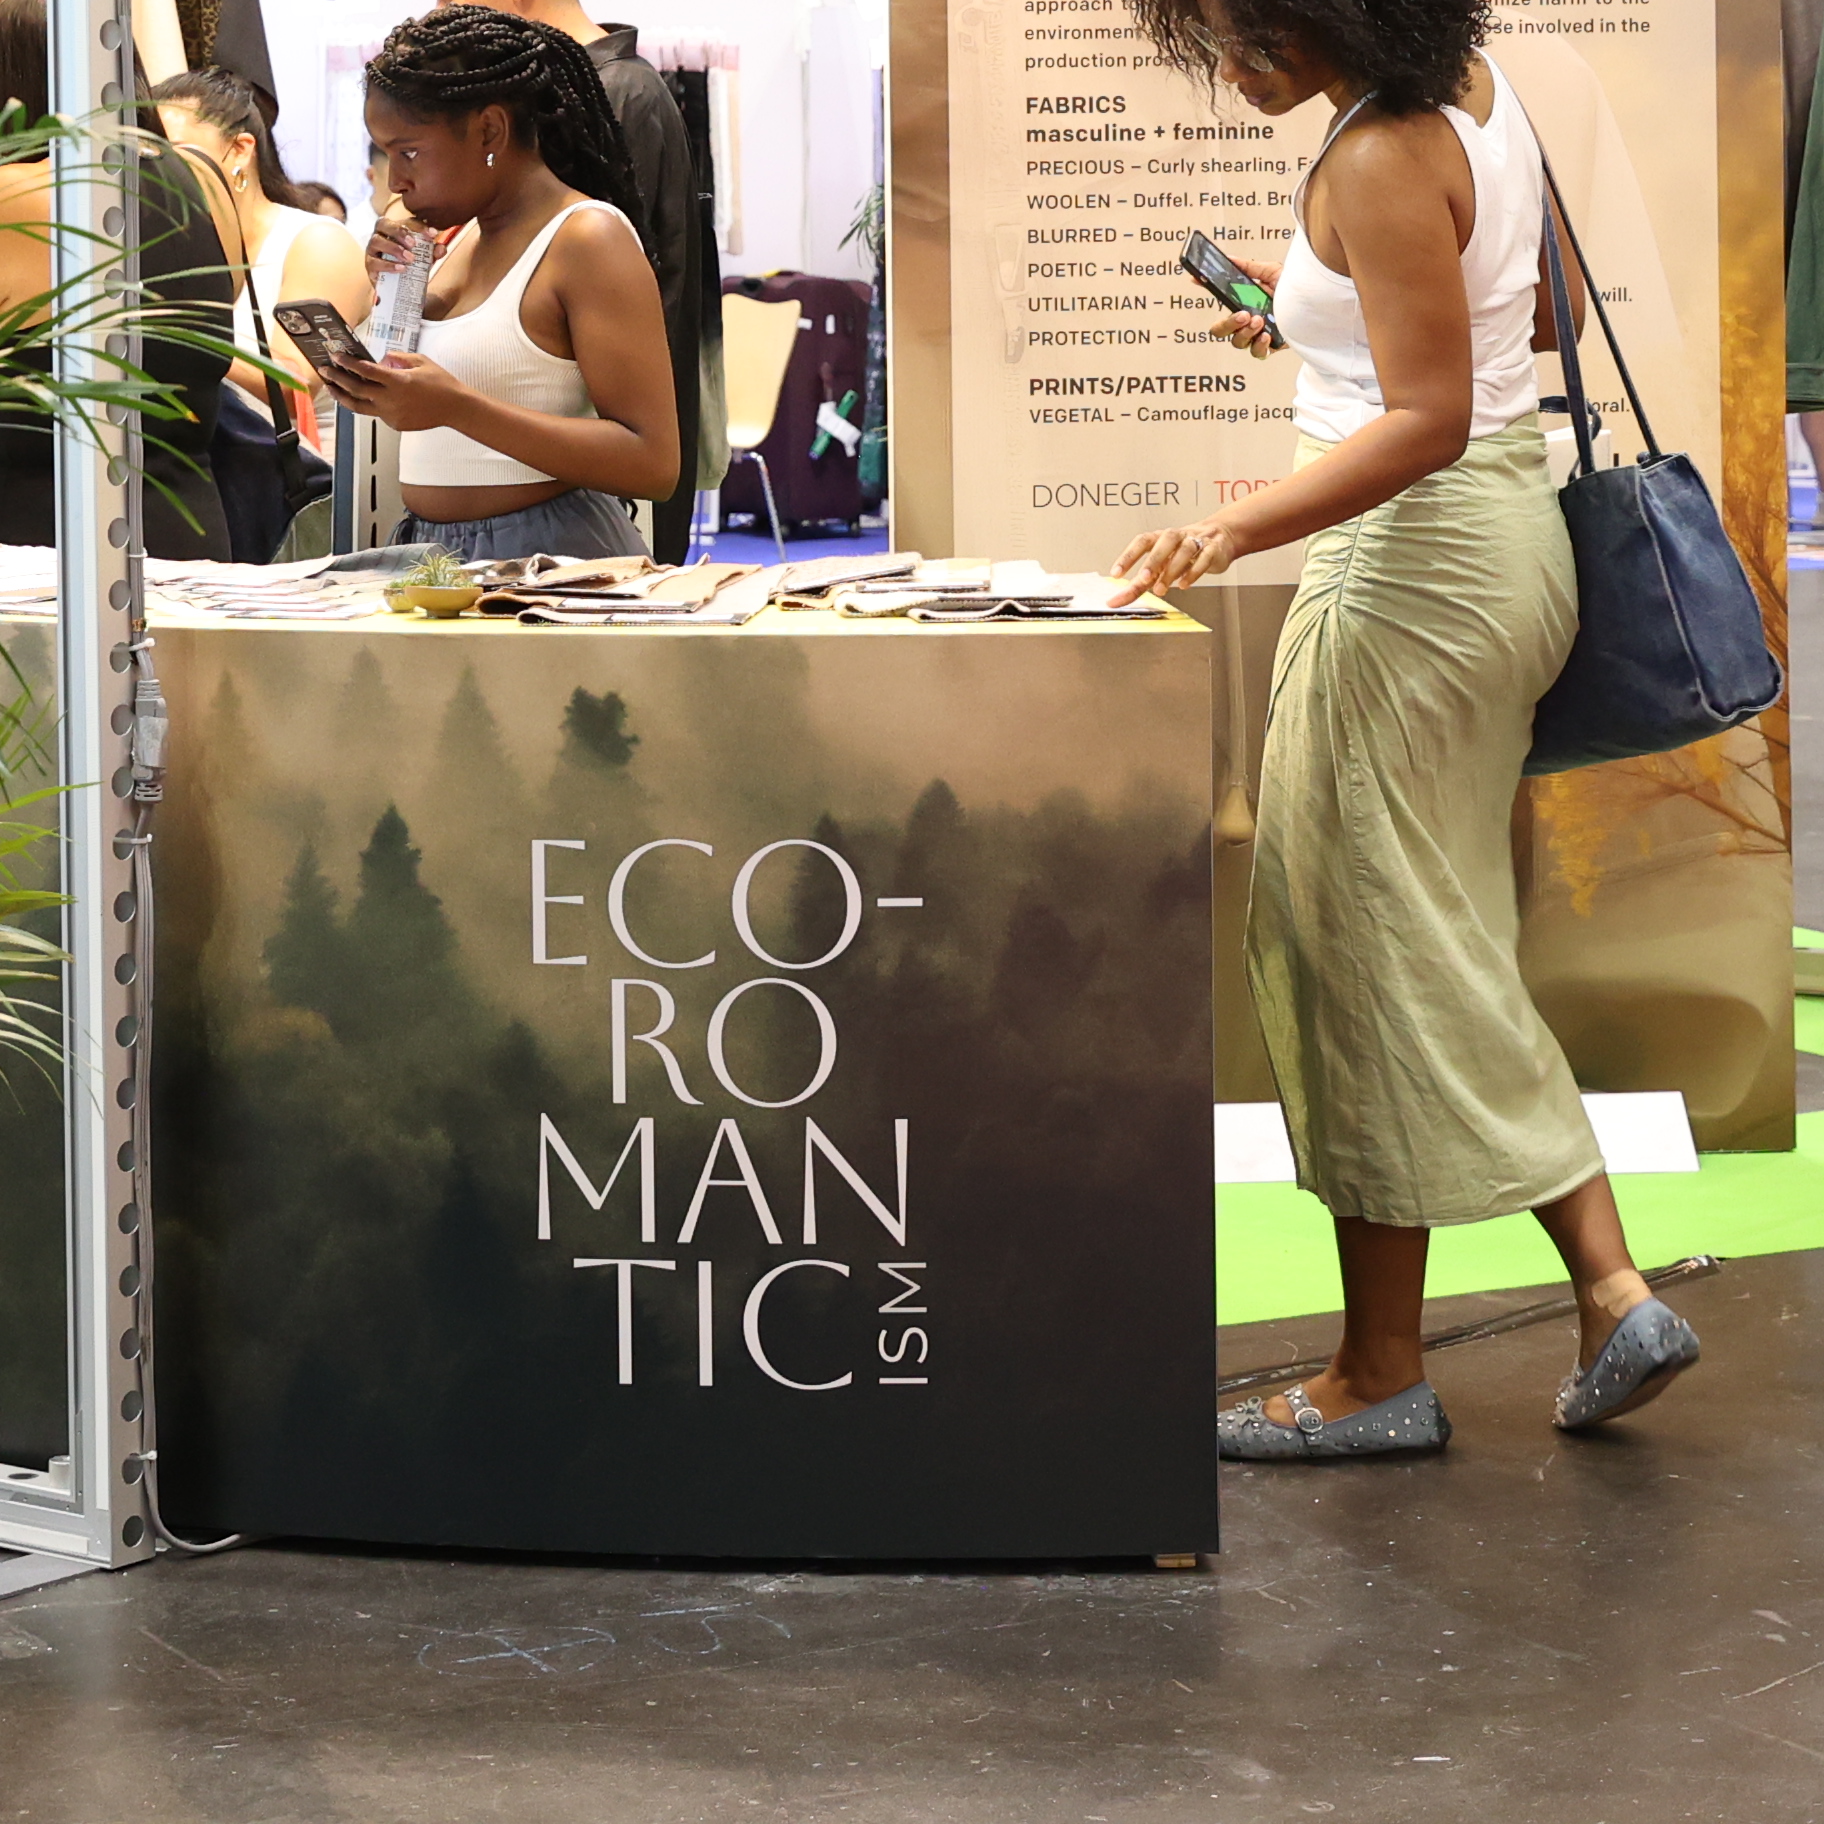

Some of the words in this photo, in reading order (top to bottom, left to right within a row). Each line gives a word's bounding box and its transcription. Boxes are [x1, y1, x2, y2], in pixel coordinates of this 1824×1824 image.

[1518, 18, 1594, 34] involved
[1600, 18, 1616, 33] in
[1621, 17, 1650, 33] the
[1025, 52, 1127, 71] production
[1026, 95, 1126, 114] FABRICS
[1026, 124, 1146, 142] masculine
[1173, 121, 1274, 141] feminine
[1026, 159, 1124, 175] PRECIOUS
[1147, 158, 1195, 176] Curly
[1201, 157, 1291, 175] shearling.
[1027, 193, 1111, 210] WOOLEN
[1134, 192, 1193, 208] Duffel.
[1199, 191, 1261, 207] Felted.
[1027, 228, 1117, 244] BLURRED
[1213, 225, 1254, 241] Hair.
[1261, 225, 1296, 241] Irre
[1028, 262, 1097, 278] POETIC
[1028, 295, 1147, 312] UTILITARIAN
[1028, 330, 1151, 346] PROTECTION
[1029, 374, 1246, 396] PRINTS/PATTERNS
[1029, 407, 1114, 423] VEGETAL
[1136, 405, 1249, 423] Camouflage
[1254, 404, 1297, 422] jacq
[1033, 481, 1180, 508] DONEGER
[530, 838, 924, 970] ECO-
[610, 977, 838, 1108] RO
[537, 1112, 909, 1247] MAN
[573, 1257, 853, 1390] TIC
[878, 1261, 929, 1385] ISM
